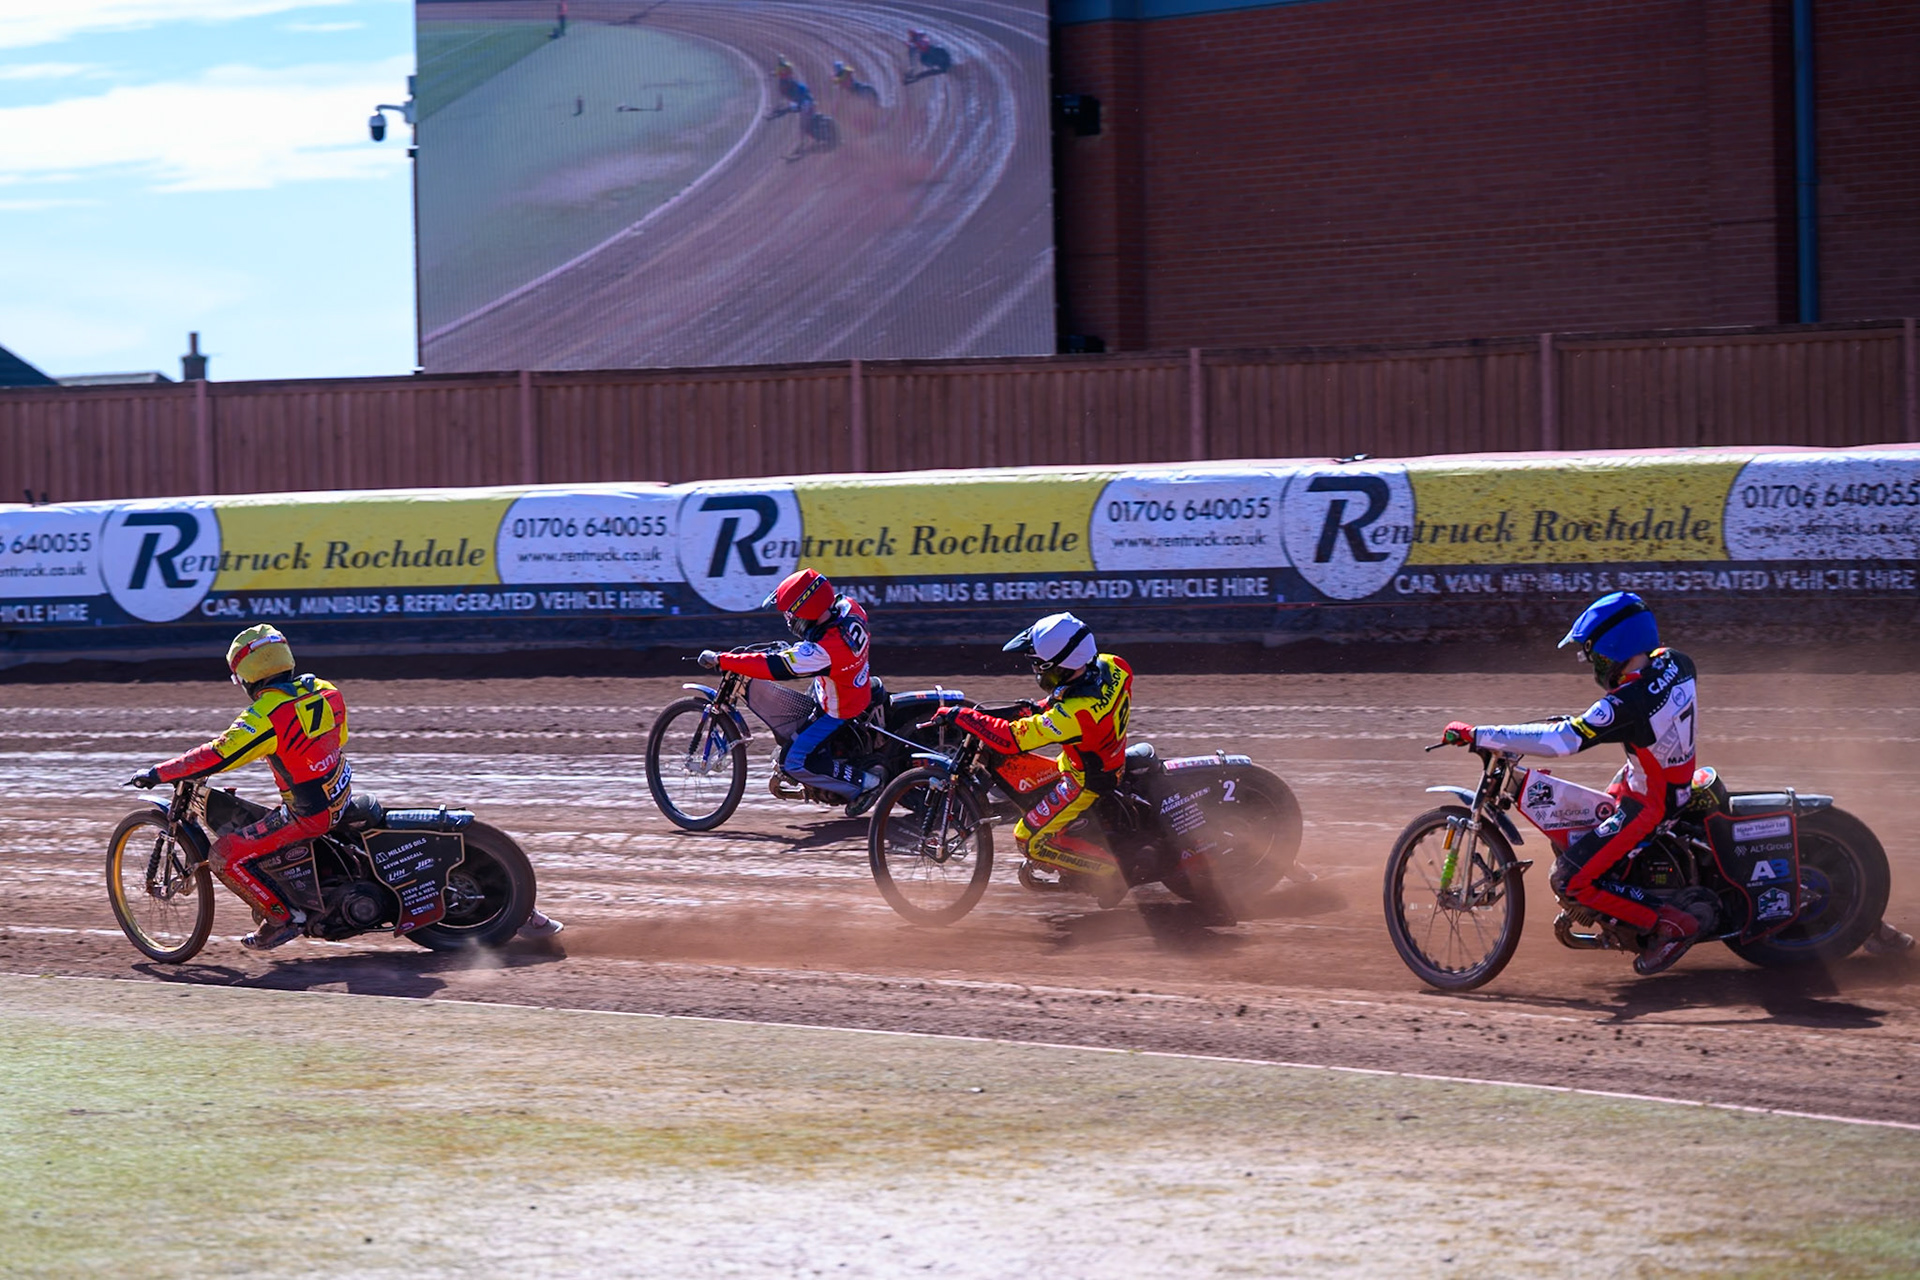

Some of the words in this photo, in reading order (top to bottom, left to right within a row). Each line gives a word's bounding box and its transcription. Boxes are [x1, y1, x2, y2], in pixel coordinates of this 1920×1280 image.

[1744, 484, 1817, 509] 01706
[1823, 481, 1919, 507] 640055
[1108, 500, 1176, 522] 01706
[1184, 497, 1271, 521] 640055
[512, 517, 578, 538] 01706
[584, 515, 667, 538] 640055
[1530, 506, 1713, 543] Rochdale
[10, 532, 92, 555] 640055
[909, 521, 1079, 556] Rochdale
[1111, 529, 1268, 549] www.rentruck.co.uk
[323, 538, 486, 569] Rochdale
[517, 546, 663, 563] www.rentruck.co.uk
[886, 582, 970, 604] MINIBUS
[973, 581, 991, 602] &
[993, 578, 1134, 601] REFRIGERATED
[1137, 577, 1218, 599] VEHICLE
[1222, 576, 1269, 597] HIRE
[1597, 571, 1613, 592] &
[1617, 570, 1770, 591] REFRIGERATED
[1771, 569, 1861, 590] VEHICLE
[1864, 569, 1917, 590] HIRE
[201, 598, 245, 618] CAR,
[247, 597, 296, 617] VAN,
[299, 594, 381, 615] MINIBUS
[384, 594, 400, 613] &
[402, 590, 536, 613] REFRIGERATED
[540, 590, 617, 611] VEHICLE
[619, 590, 665, 609] HIRE
[790, 580, 821, 613] SCOTT
[47, 603, 89, 622] HIRE
[849, 624, 867, 653] 2
[1090, 665, 1122, 714] THOMPSON
[305, 697, 324, 734] 7
[1679, 702, 1694, 748] 7
[242, 723, 257, 735] PRO
[1049, 724, 1063, 736] PRO
[1161, 792, 1181, 808] A&S
[1222, 780, 1236, 802] 2
[1550, 807, 1590, 818] ALT-Group
[387, 843, 413, 858] MILLERS
[413, 837, 427, 848] OILS
[1750, 842, 1793, 854] ALT-Group
